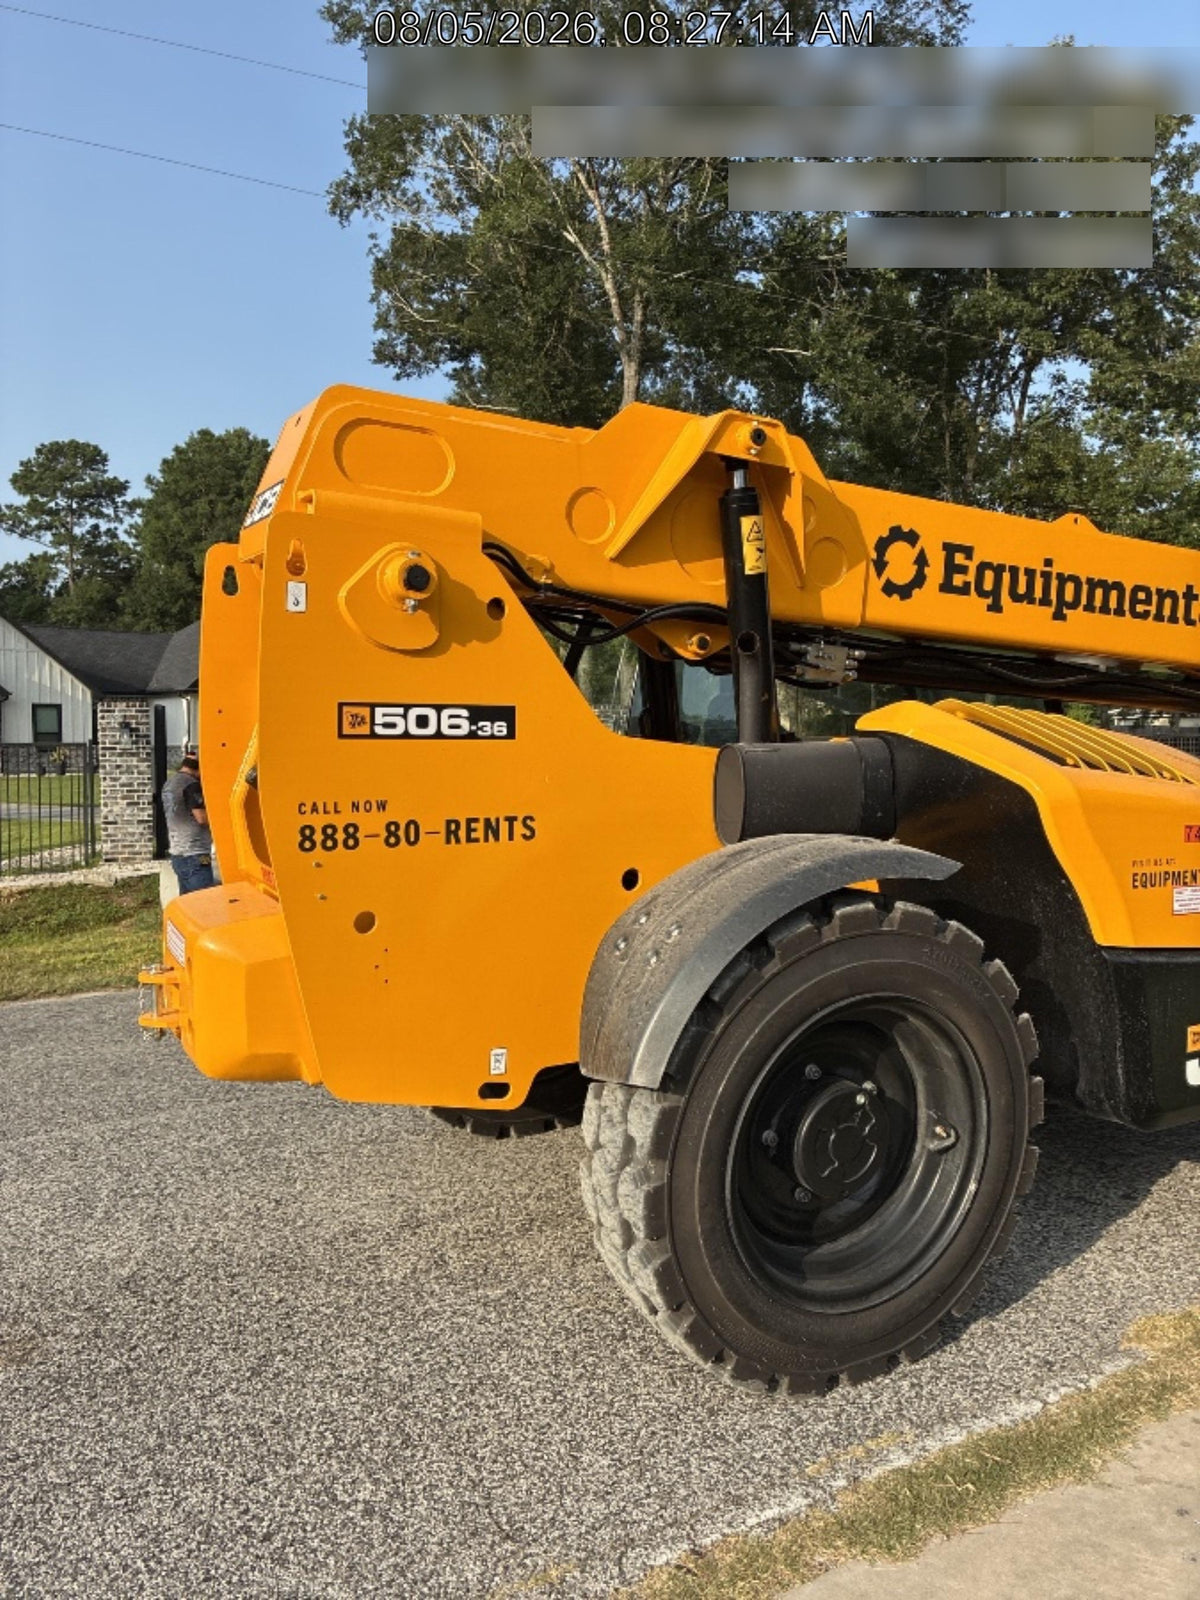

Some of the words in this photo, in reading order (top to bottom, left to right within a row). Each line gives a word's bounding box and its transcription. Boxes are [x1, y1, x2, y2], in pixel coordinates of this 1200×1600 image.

[939, 541, 1200, 627] Equipment
[373, 706, 508, 737] 506-36
[297, 800, 342, 815] CALL
[351, 799, 389, 814] NOW
[297, 815, 537, 853] 888-80-RENTS
[1132, 868, 1200, 889] EQUIPMEN
